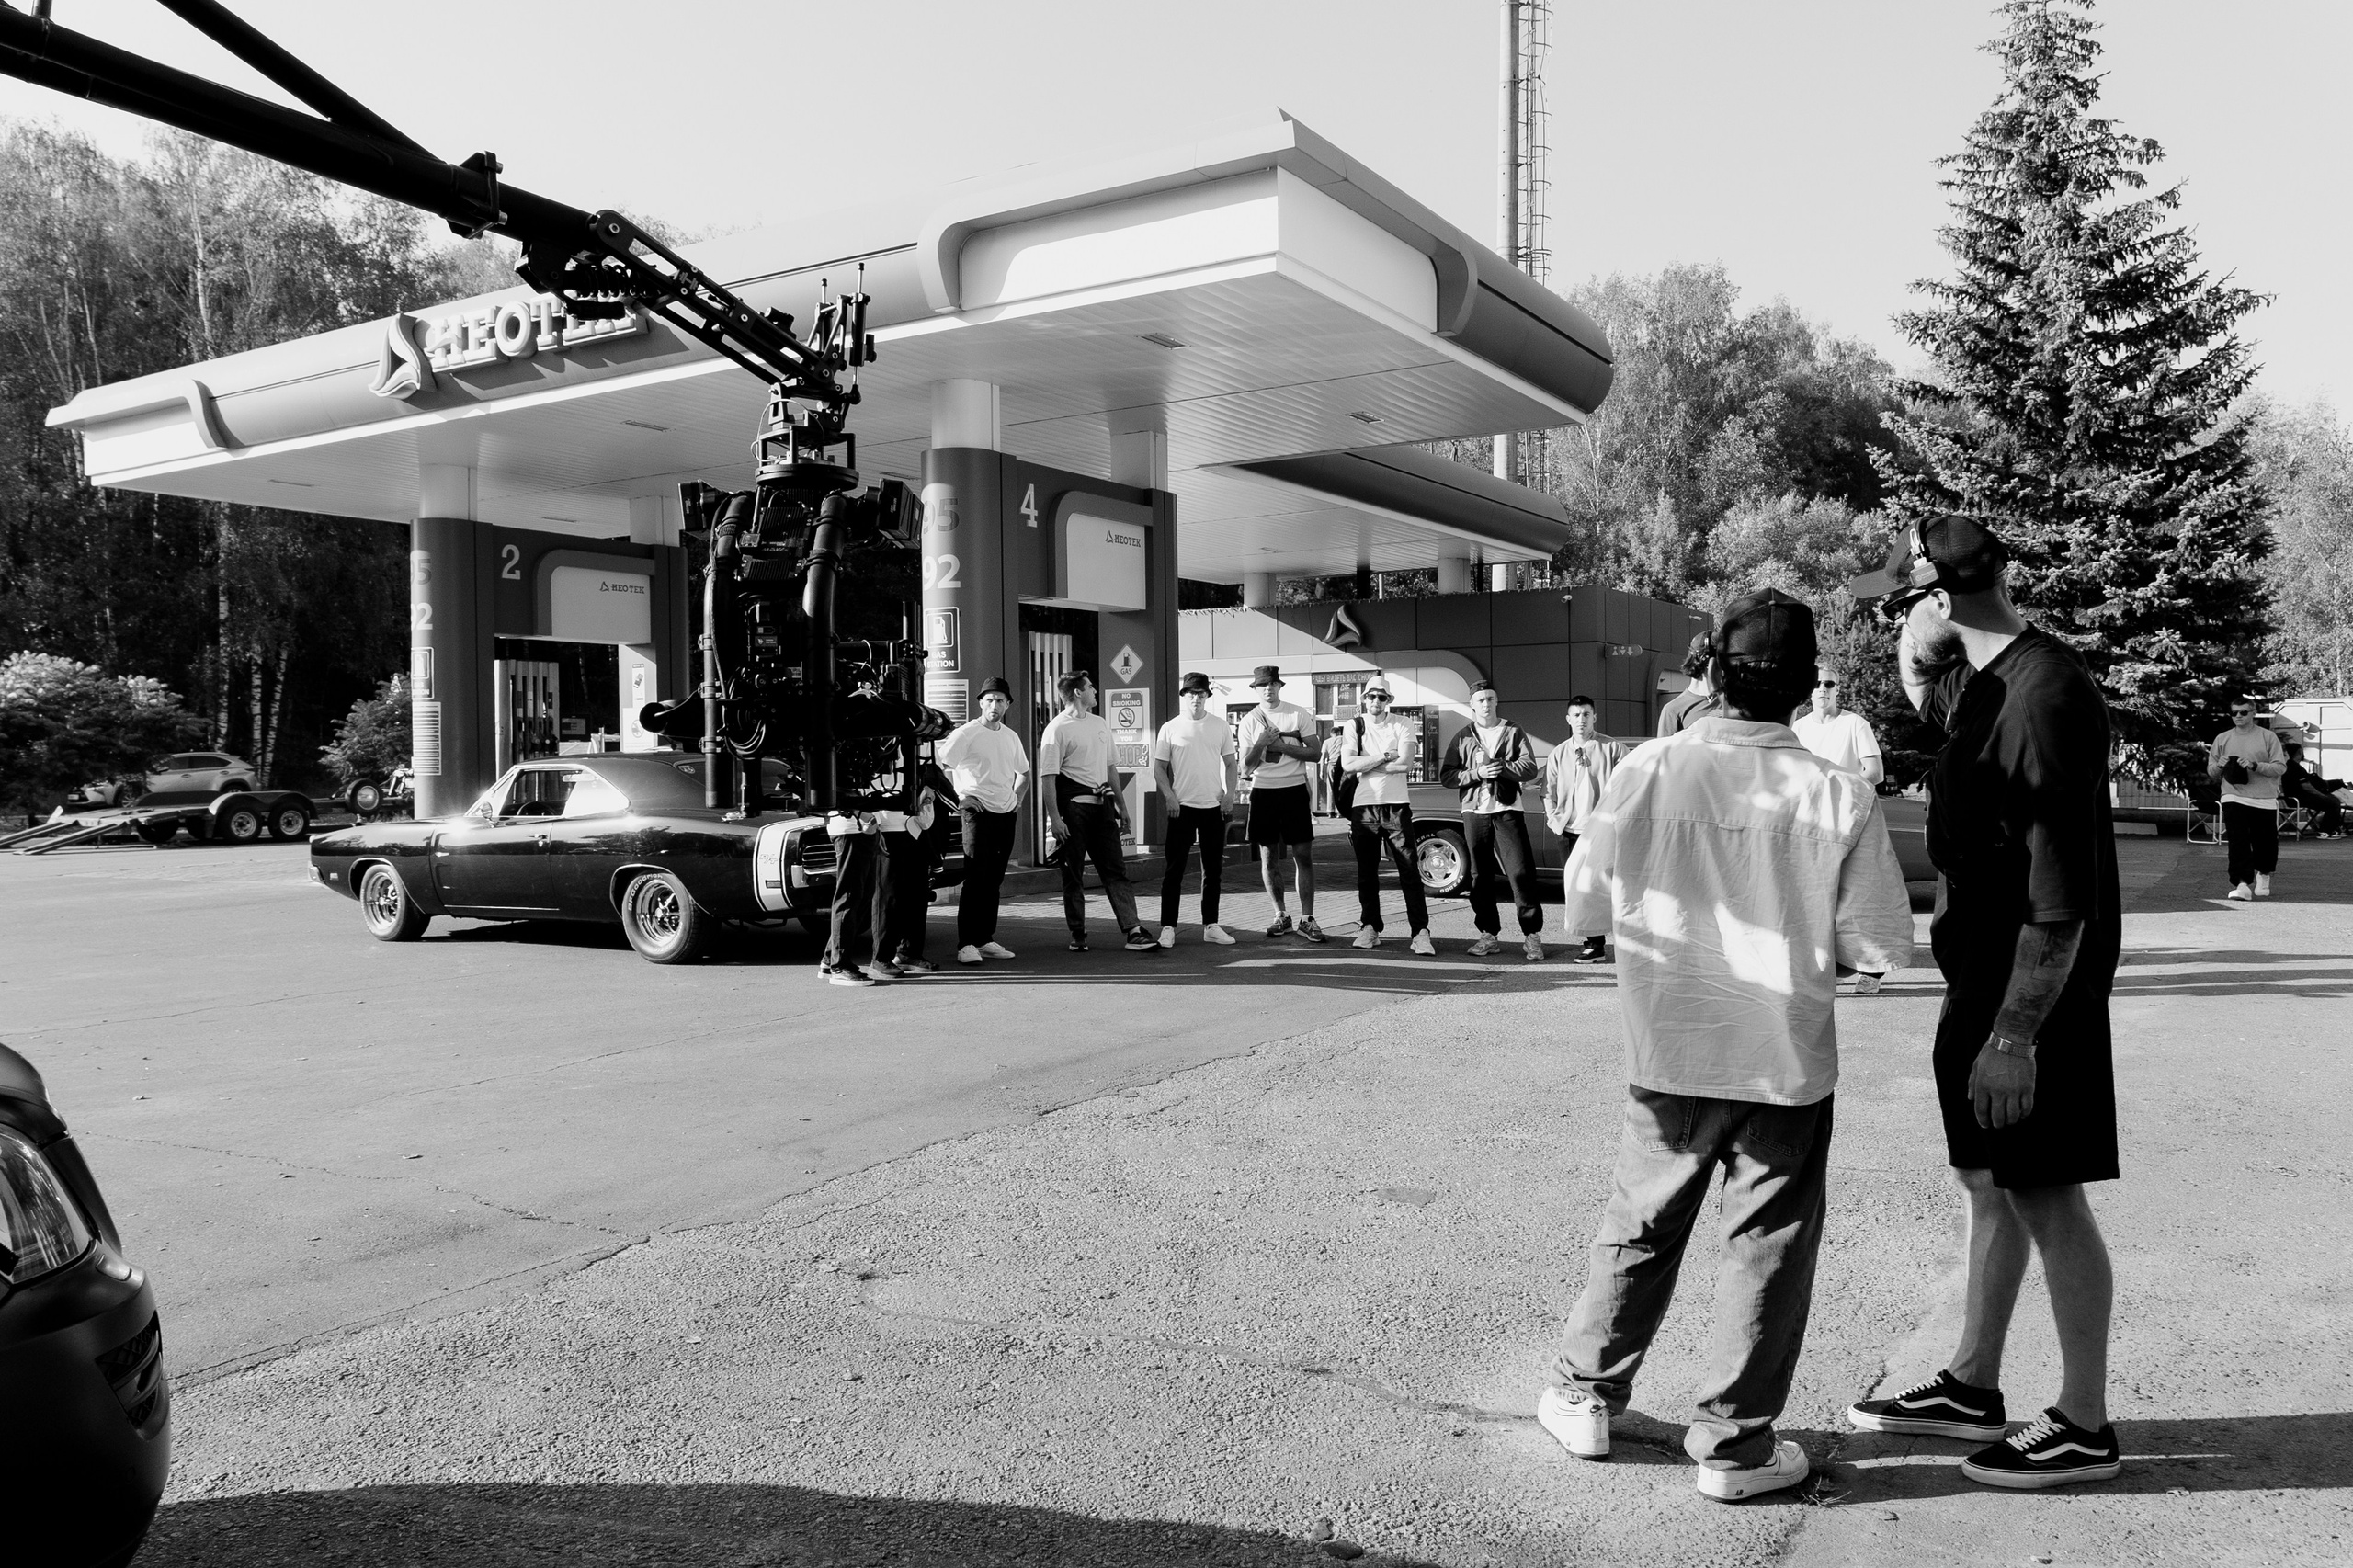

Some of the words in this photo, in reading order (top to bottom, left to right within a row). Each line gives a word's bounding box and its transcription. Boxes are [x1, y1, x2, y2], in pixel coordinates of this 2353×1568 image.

[1020, 483, 1039, 528] 4
[501, 544, 521, 580] 2
[411, 558, 432, 585] 5
[923, 554, 961, 591] 92
[931, 651, 947, 659] GAS
[926, 659, 955, 668] STATION
[1120, 667, 1132, 676] GAS
[1116, 744, 1142, 766] HOP
[1120, 837, 1136, 846] ОТЕК
[1416, 833, 1436, 843] ERAL
